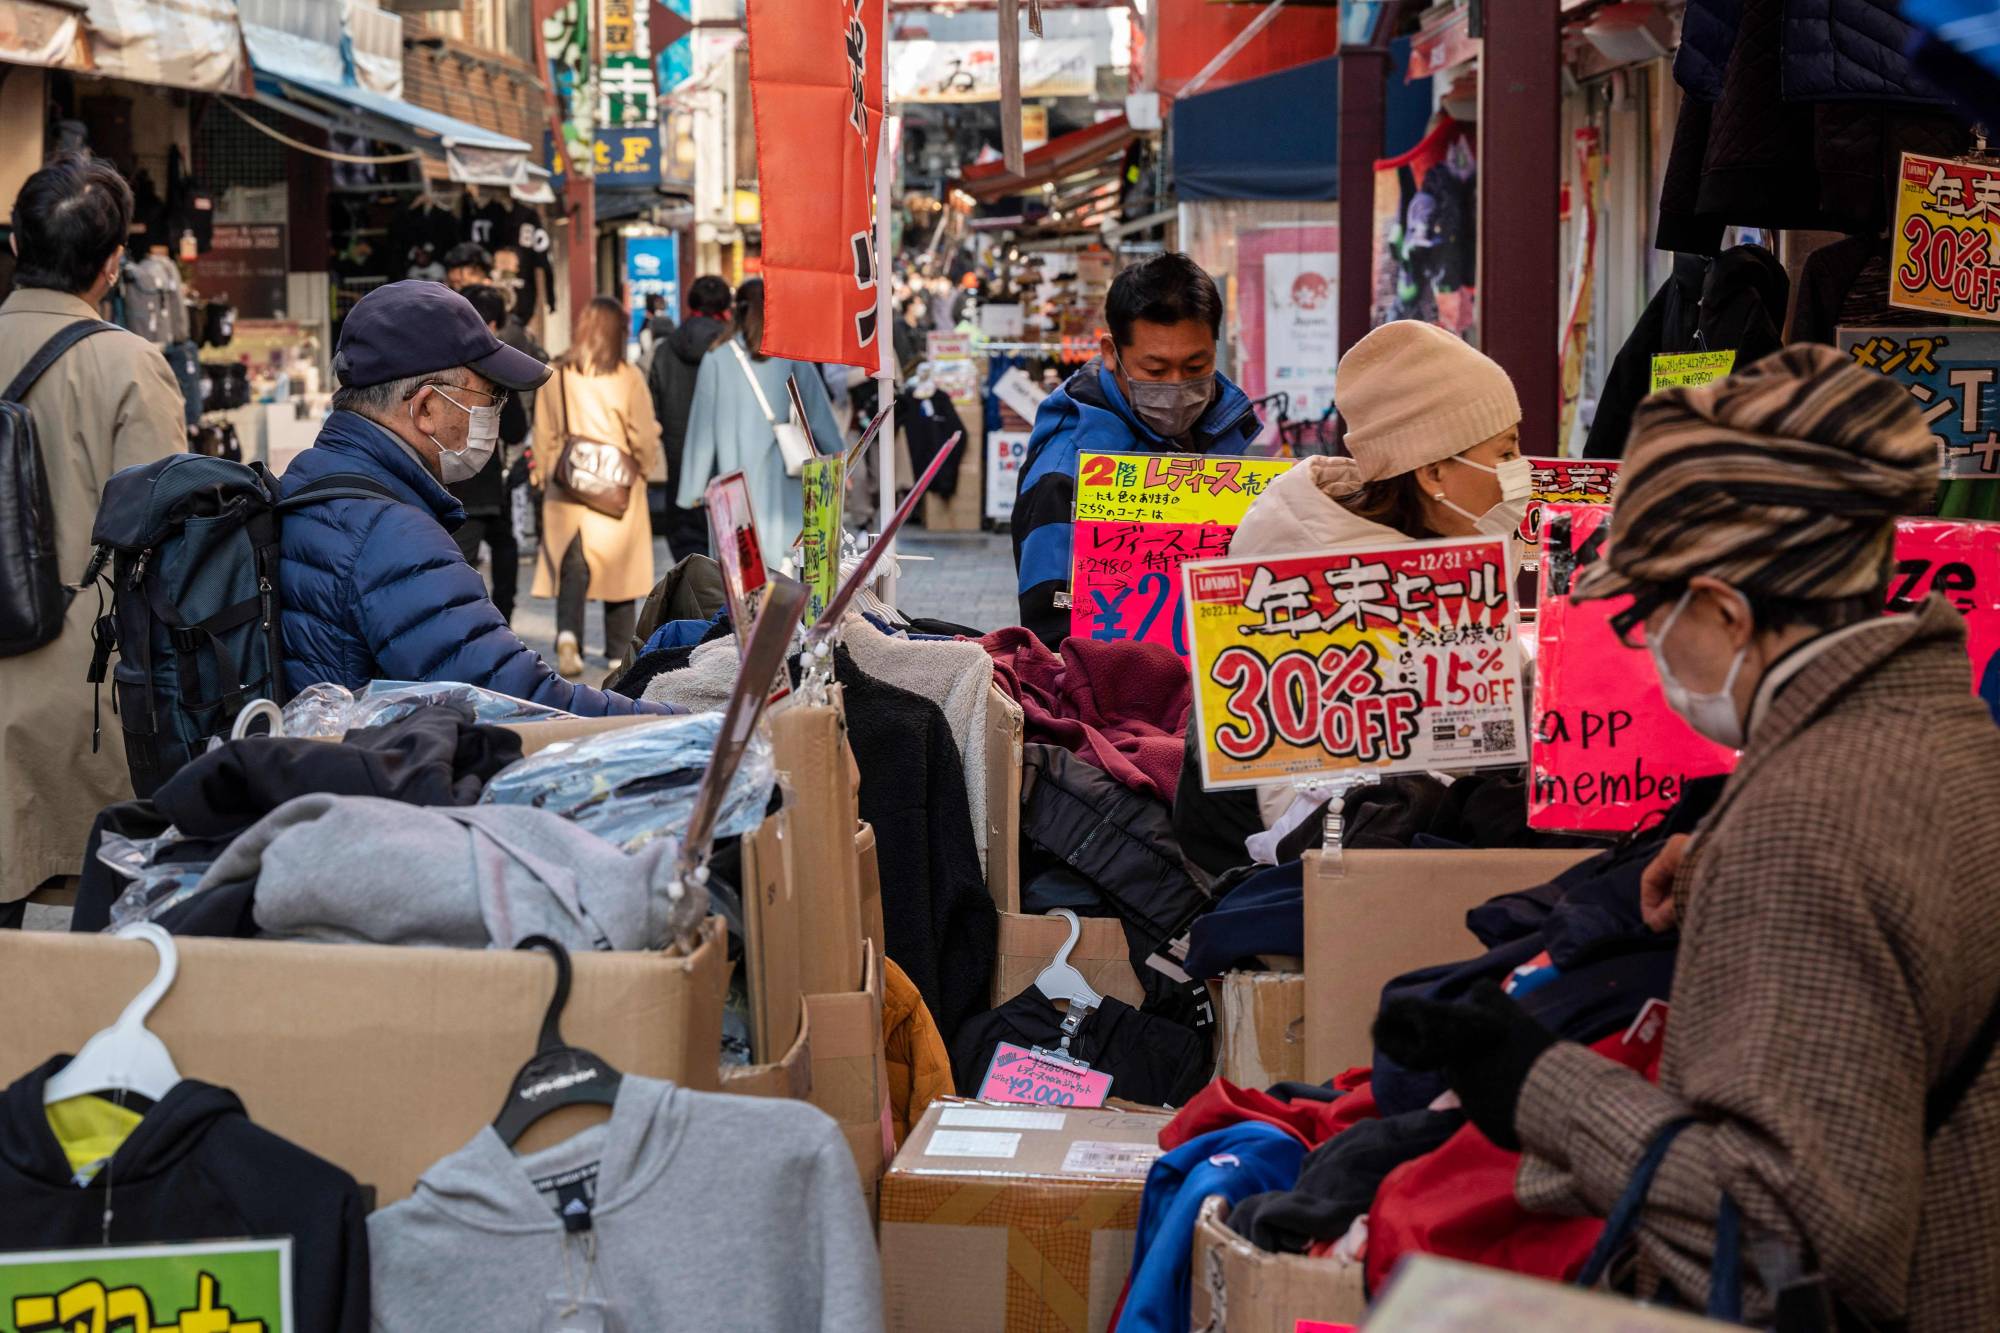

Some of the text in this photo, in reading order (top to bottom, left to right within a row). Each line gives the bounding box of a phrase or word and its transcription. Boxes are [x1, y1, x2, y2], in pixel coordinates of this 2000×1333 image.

[1899, 214, 1991, 292] 30%
[1850, 336, 1949, 376] メンズ
[1198, 573, 1238, 592] LONDON
[1237, 557, 1507, 640] 年末セール
[1200, 604, 1239, 618] 2022.12
[1210, 640, 1424, 764] 30% OFF
[1420, 647, 1515, 707] 15% OFF
[1539, 709, 1632, 750] app
